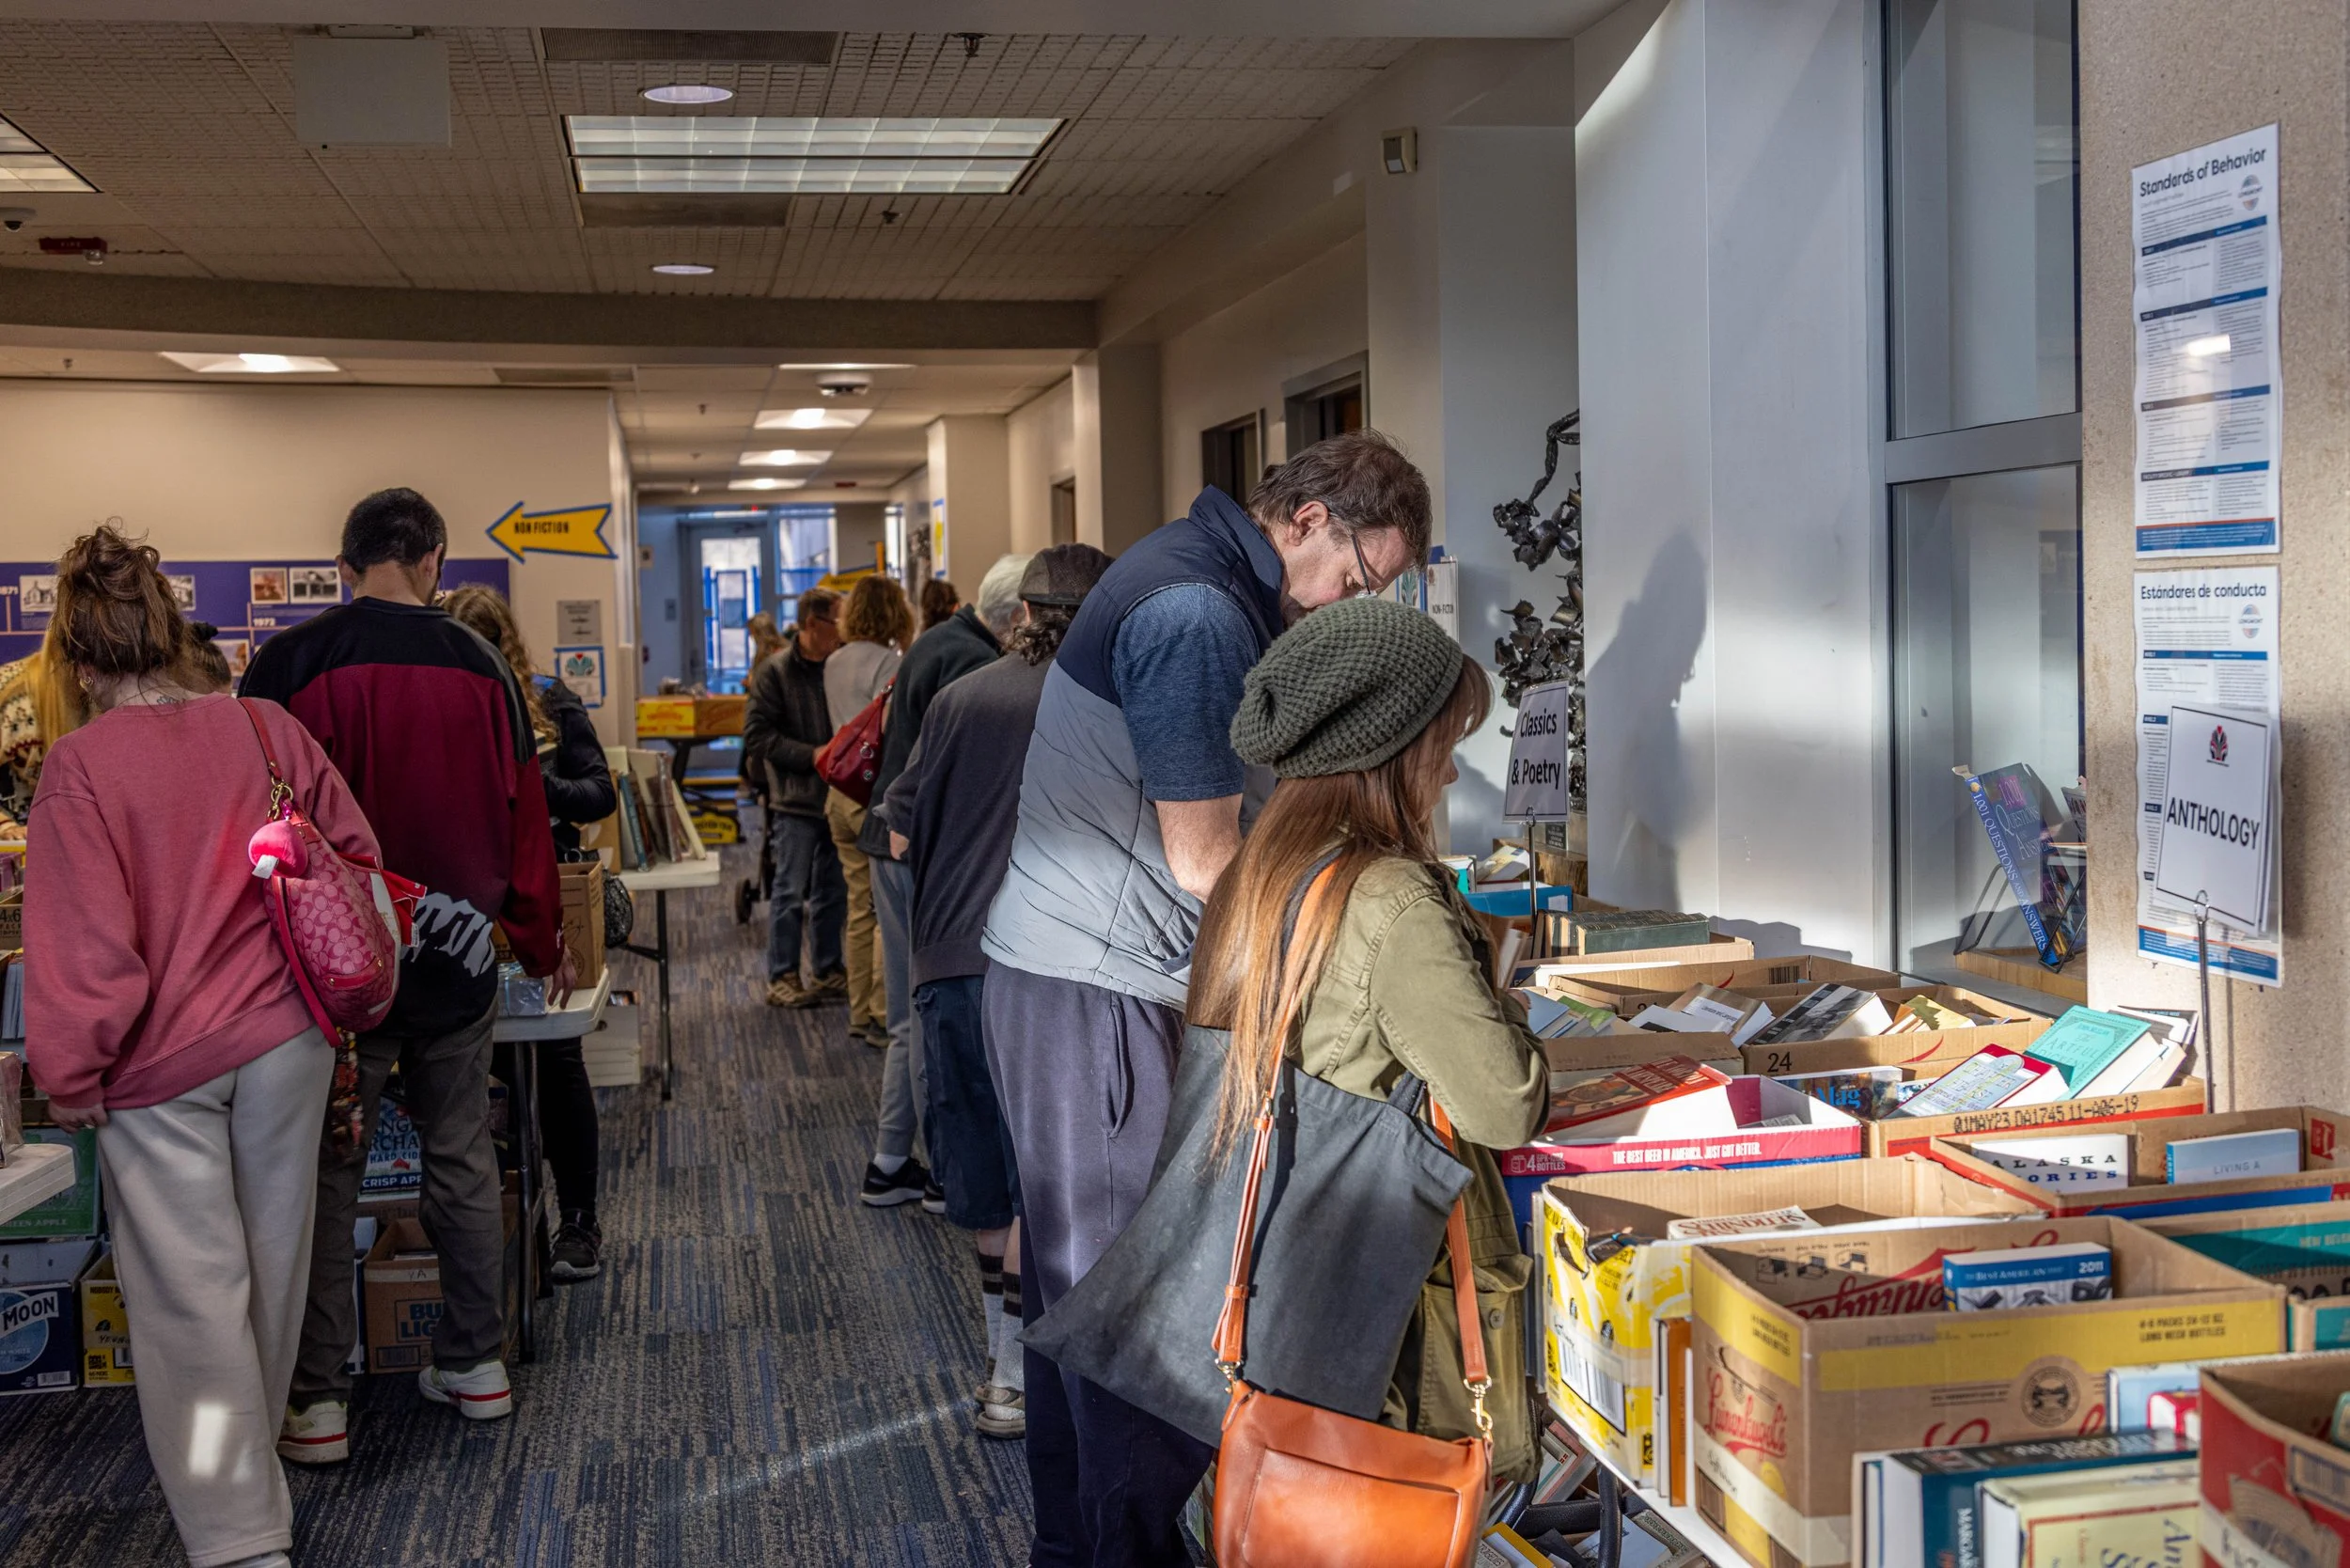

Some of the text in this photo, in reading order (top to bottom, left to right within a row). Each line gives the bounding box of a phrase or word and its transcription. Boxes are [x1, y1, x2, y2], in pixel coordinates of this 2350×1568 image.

[2139, 148, 2266, 197] Standards of Behavior
[514, 522, 569, 533] NON FICTION
[2141, 583, 2266, 600] Estándares de conducta
[1520, 708, 1557, 738] Classics
[1512, 759, 1560, 791] & Poetry
[2167, 797, 2260, 850] ANTHOLOGY
[1973, 792, 1989, 818] 1,001
[1984, 817, 2018, 882] QUESTIONS
[2019, 898, 2048, 951] ANSWERS
[2047, 1036, 2100, 1059] ARTFUL
[1768, 1051, 1793, 1074] 24
[1953, 1094, 2139, 1134] 01MAY23 DA1745 11-A06-19
[370, 1152, 396, 1164] HARD
[1527, 1154, 1536, 1172] 4
[1612, 1141, 1762, 1165] THE BEST BEER IN AMERICA. JUST GOT BETTER.
[1992, 1154, 2117, 1169] ALASKA
[1536, 1161, 1566, 1172] BOTTLES
[2019, 1170, 2117, 1183] ORIES
[2214, 1160, 2261, 1175] LIVING A
[363, 1177, 397, 1188] CRISP
[2078, 1261, 2104, 1274] 2011
[3, 1296, 55, 1331] MOON
